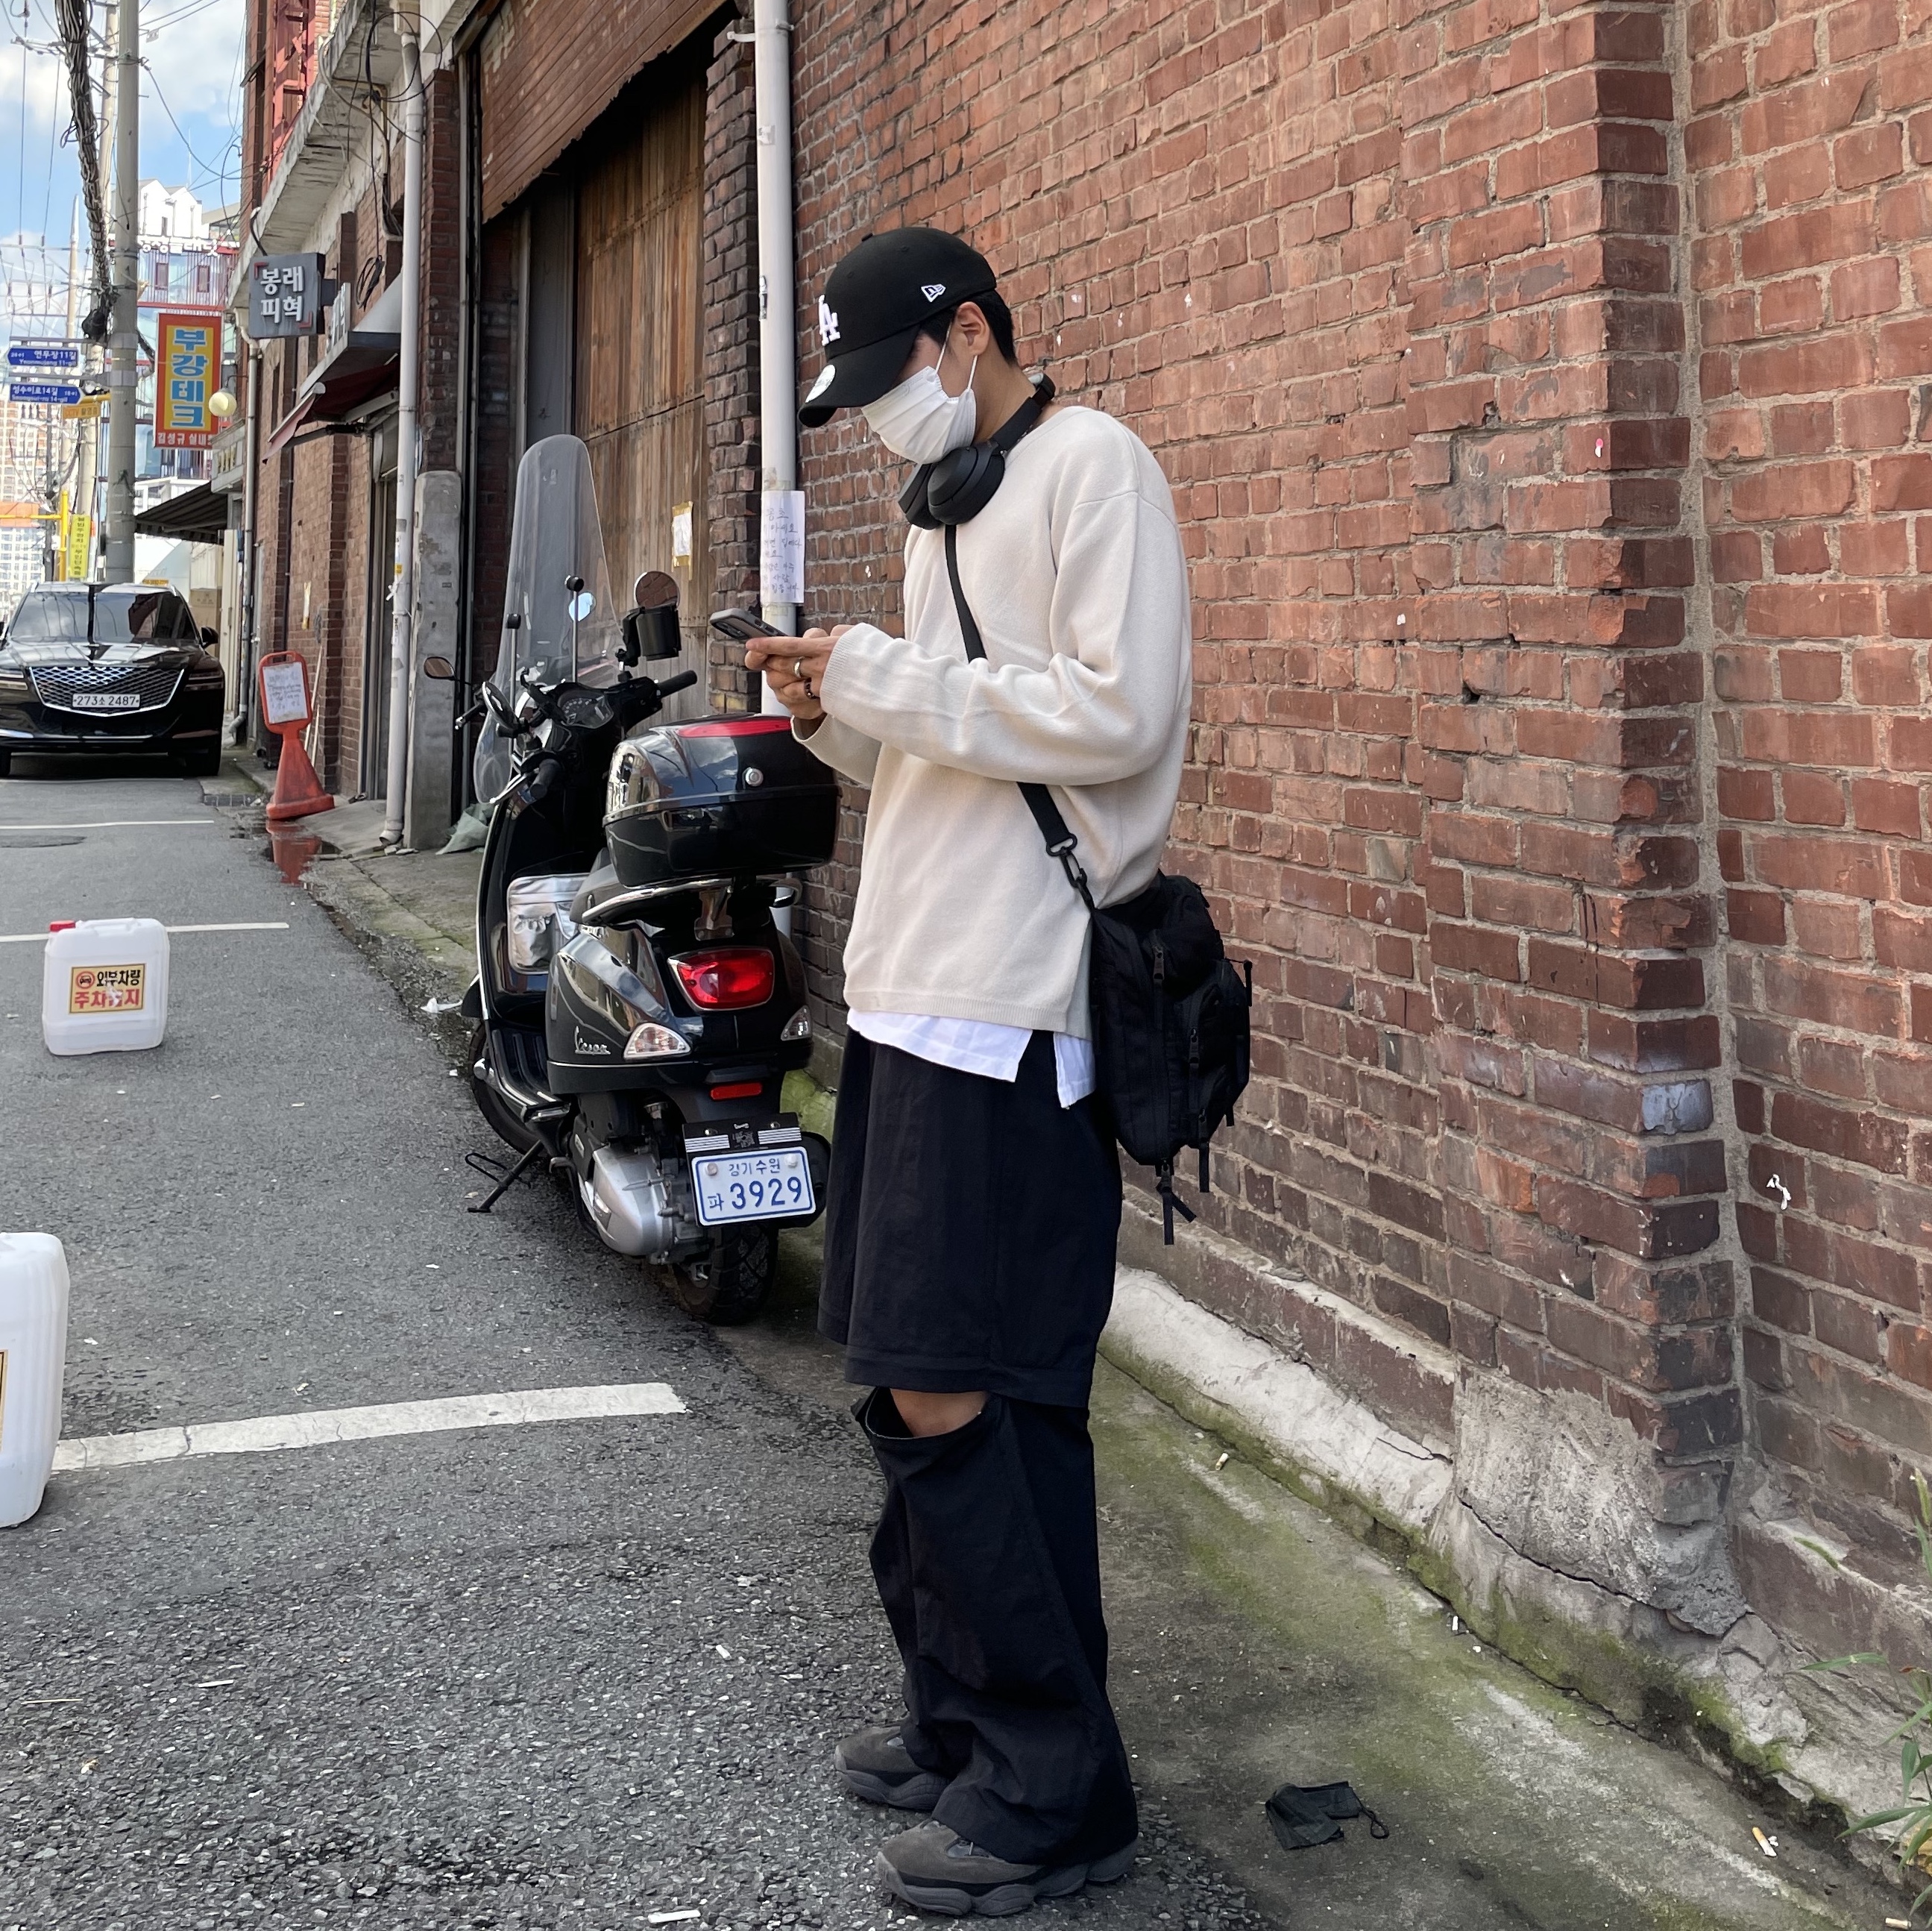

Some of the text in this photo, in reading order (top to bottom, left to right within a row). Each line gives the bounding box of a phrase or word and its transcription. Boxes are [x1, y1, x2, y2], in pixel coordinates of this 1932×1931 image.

[260, 266, 303, 295] 봉래
[260, 295, 302, 323] 피혁
[819, 295, 841, 346] LA
[172, 328, 208, 427] 부강테크
[13, 385, 58, 396] 성수이로14길
[157, 432, 186, 445] 김성규
[77, 696, 136, 706] 273소 2487
[96, 970, 141, 987] 외부차량
[756, 1158, 781, 1175] 수원
[708, 1176, 802, 1211] 파 3929
